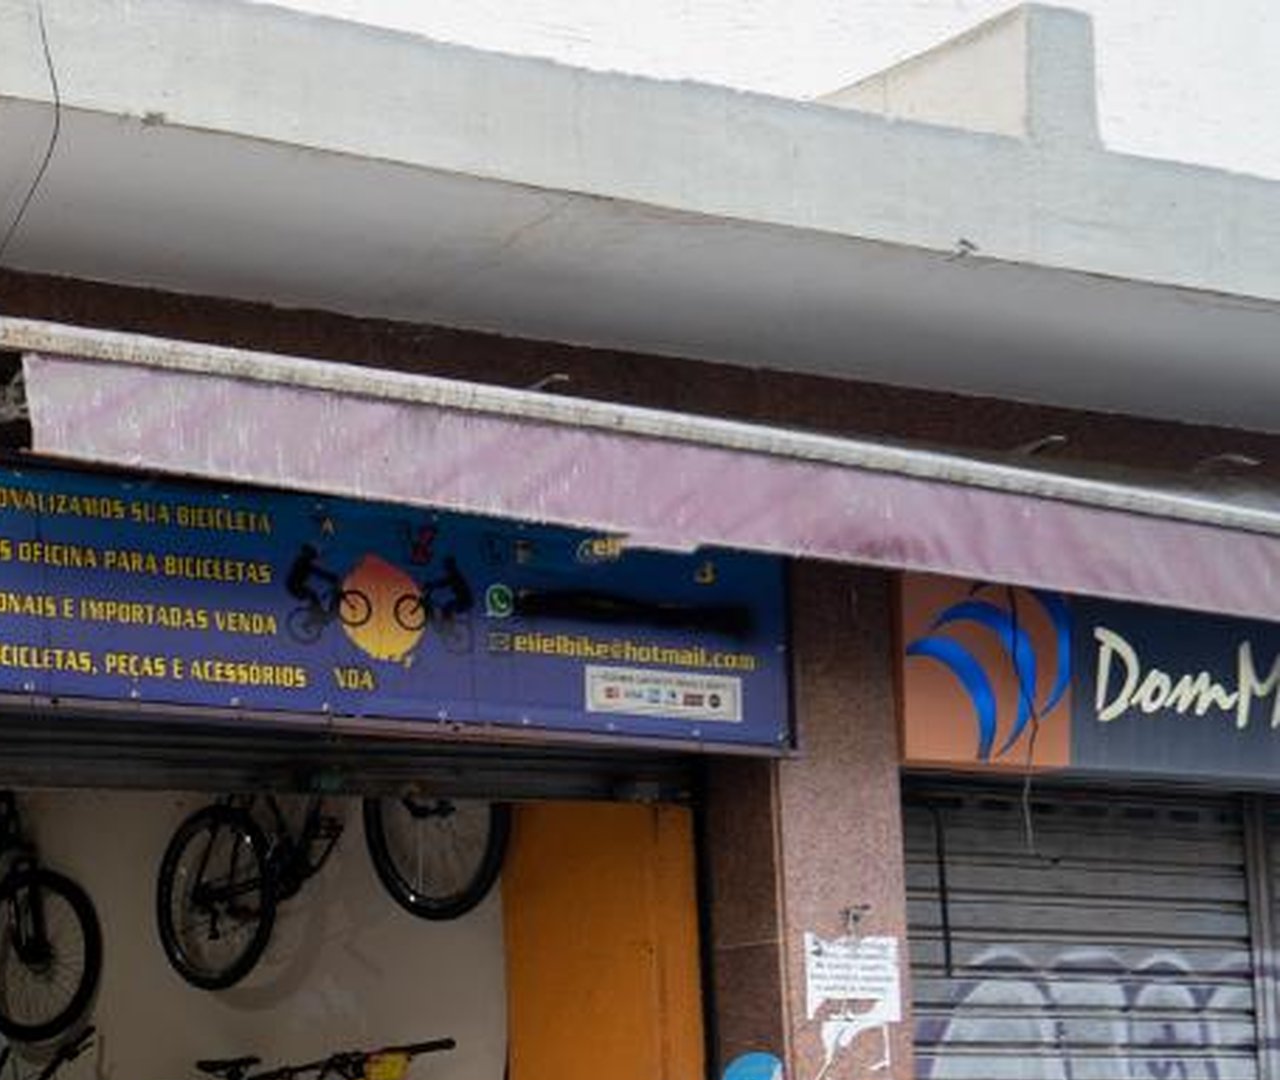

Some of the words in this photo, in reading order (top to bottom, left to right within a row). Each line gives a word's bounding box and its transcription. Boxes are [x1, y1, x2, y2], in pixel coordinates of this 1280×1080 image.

[130, 500, 170, 524] SUA
[176, 506, 272, 535] BICICLETA
[18, 542, 97, 568] OFICINA
[103, 551, 160, 576] PARA
[164, 558, 273, 585] BICICLETAS
[61, 597, 75, 619] E
[80, 600, 209, 631] IMPORTADAS
[213, 609, 278, 636] VENDA
[105, 651, 166, 685] PEÇAS
[172, 657, 184, 680] E
